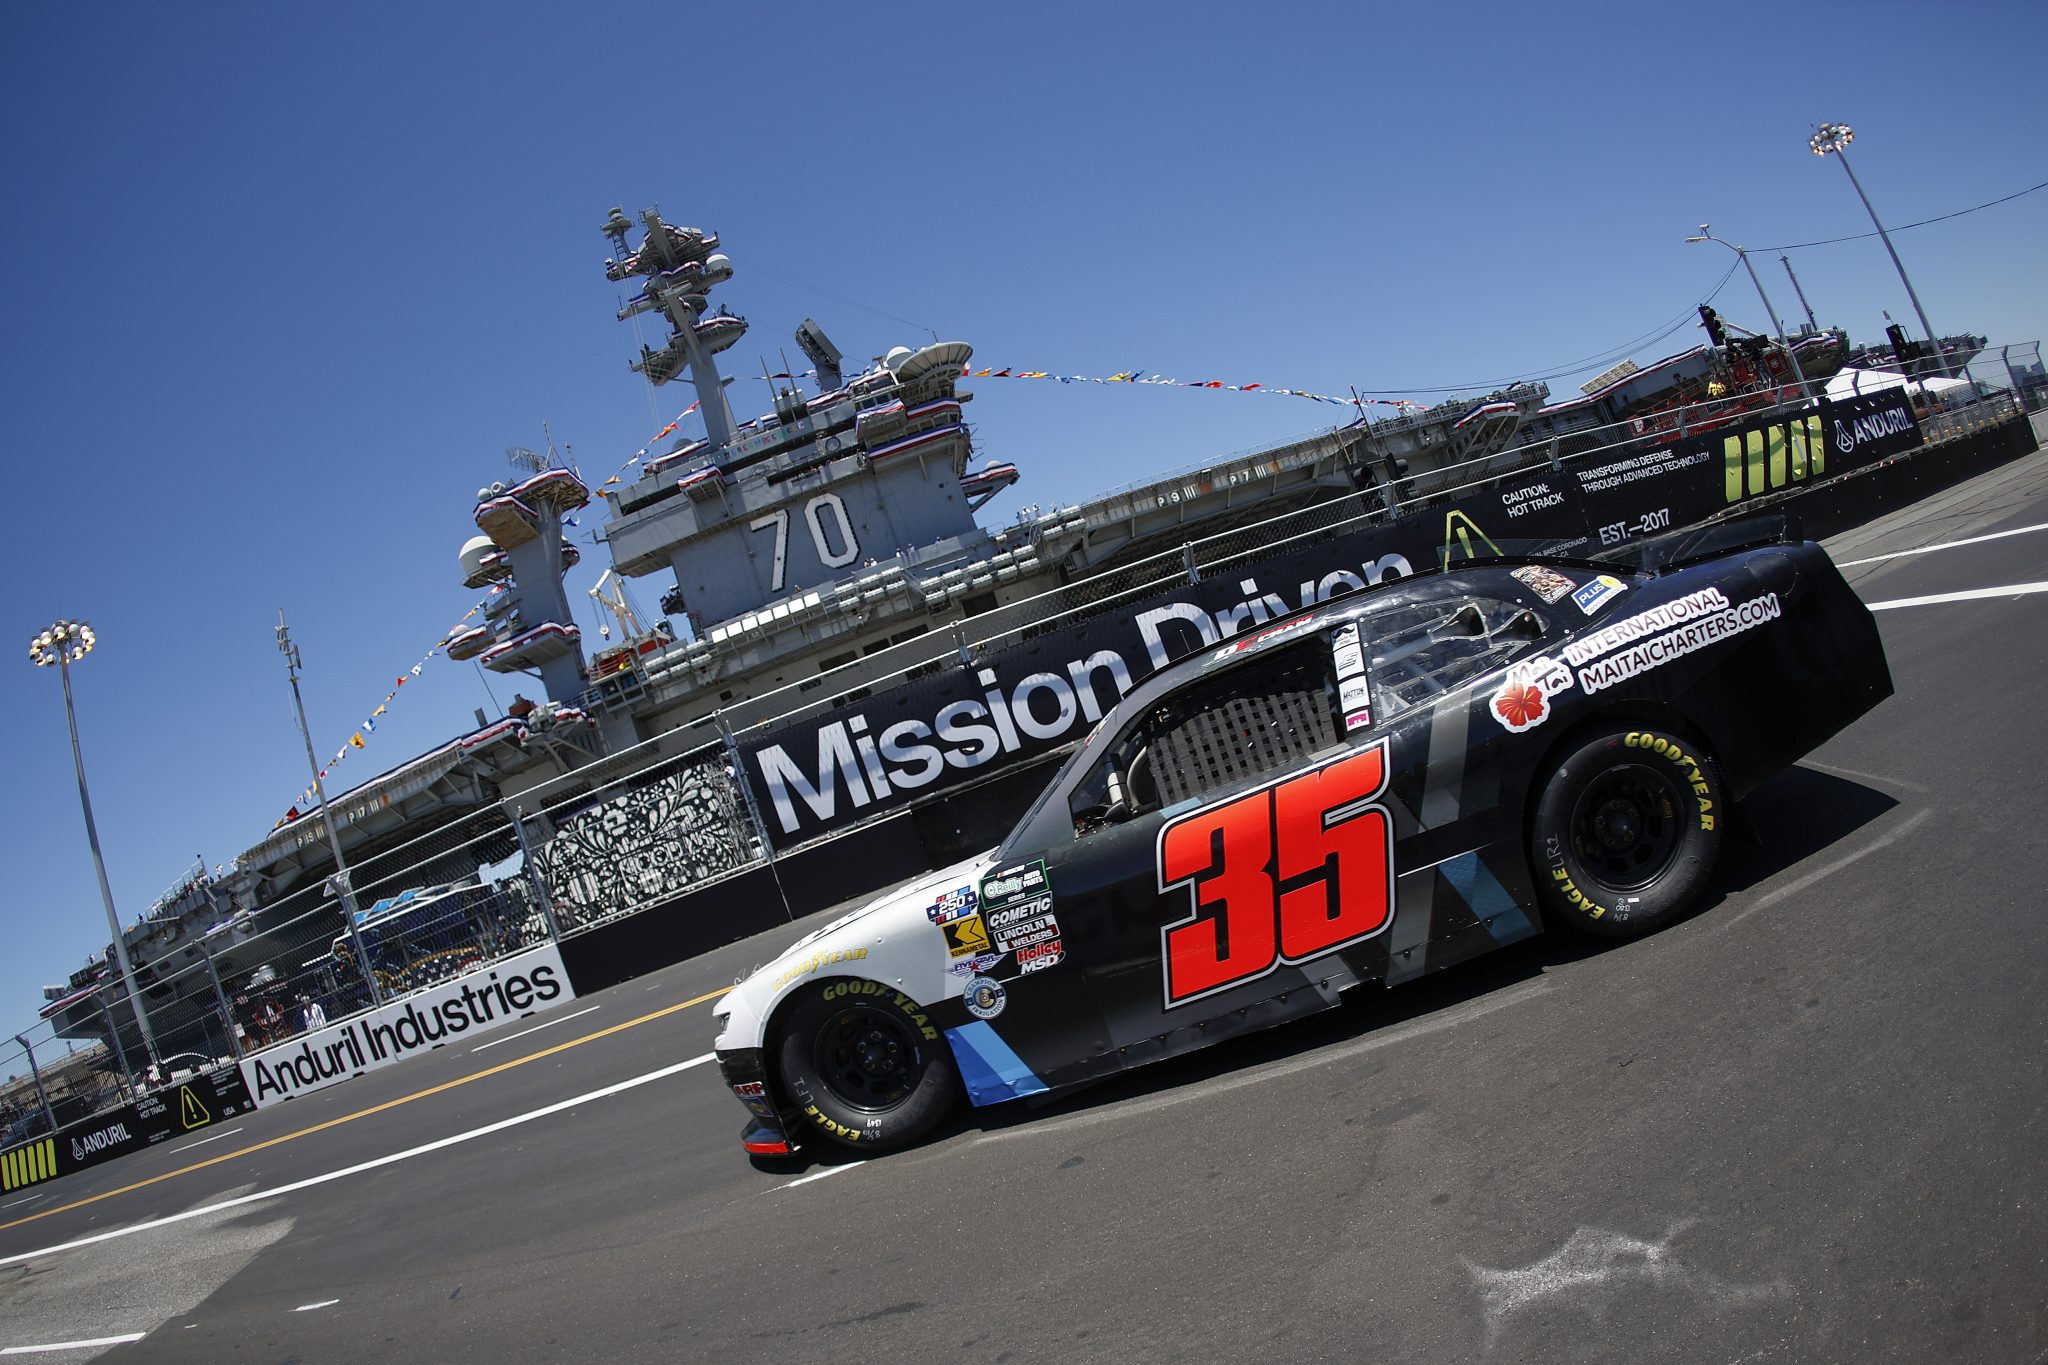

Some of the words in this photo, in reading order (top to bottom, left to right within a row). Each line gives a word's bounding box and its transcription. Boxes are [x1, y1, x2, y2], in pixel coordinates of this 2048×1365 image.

[1853, 407, 1914, 445] ANDURIL
[1243, 472, 1249, 482] 7
[1577, 457, 1640, 482] TRANSFORMING
[1639, 450, 1674, 466] DEFENSE
[1582, 474, 1623, 494] THROUGH
[1623, 464, 1663, 484] ADVANCED
[1663, 451, 1710, 473] TECHNOLOGY
[1170, 492, 1180, 502] 9
[1502, 483, 1549, 505] CAUTION:
[1507, 501, 1529, 518] HOT
[1529, 492, 1564, 511] TRACK
[750, 493, 860, 592] 70
[1543, 544, 1558, 556] BASE
[1558, 536, 1588, 552] CORONADO
[1579, 583, 1605, 603] PLUS
[1571, 590, 1726, 662] INTERNATIONAL
[1583, 597, 1778, 690] MAITAICHARTERS.COM
[1512, 661, 1549, 691] Mai
[1534, 667, 1568, 691] Tai
[756, 650, 1132, 834] Mission
[1624, 732, 1715, 831] GOODYEAR
[1023, 876, 1043, 888] PARTS
[1024, 870, 1041, 881] AUTO
[1158, 737, 1394, 1009] 35
[939, 895, 966, 915] 250
[1008, 893, 1026, 903] SERIES
[1552, 867, 1607, 920] EAGLE
[990, 898, 1051, 928] COMETIC
[997, 920, 1046, 941] LINCOLN
[1011, 929, 1053, 947] WELDERS
[952, 942, 989, 957] KENNAMETAL
[1017, 940, 1062, 965] Holley
[772, 948, 868, 992] GOODYEAR
[954, 960, 972, 971] FIVE
[974, 954, 994, 963] STAR
[1020, 954, 1059, 975] MSD
[966, 979, 998, 997] CHAMPION
[823, 981, 939, 1041] GOODYEAR
[971, 999, 1004, 1017] IRRIGATION
[255, 1023, 365, 1100] Anduril
[365, 965, 561, 1061] Industries
[137, 1097, 159, 1111] CAUTION:
[140, 1107, 151, 1119] HOT
[150, 1104, 167, 1116] TRACK
[223, 1106, 236, 1117] USA
[804, 1105, 861, 1142] EAGLE
[84, 1123, 132, 1155] ANDURIL
